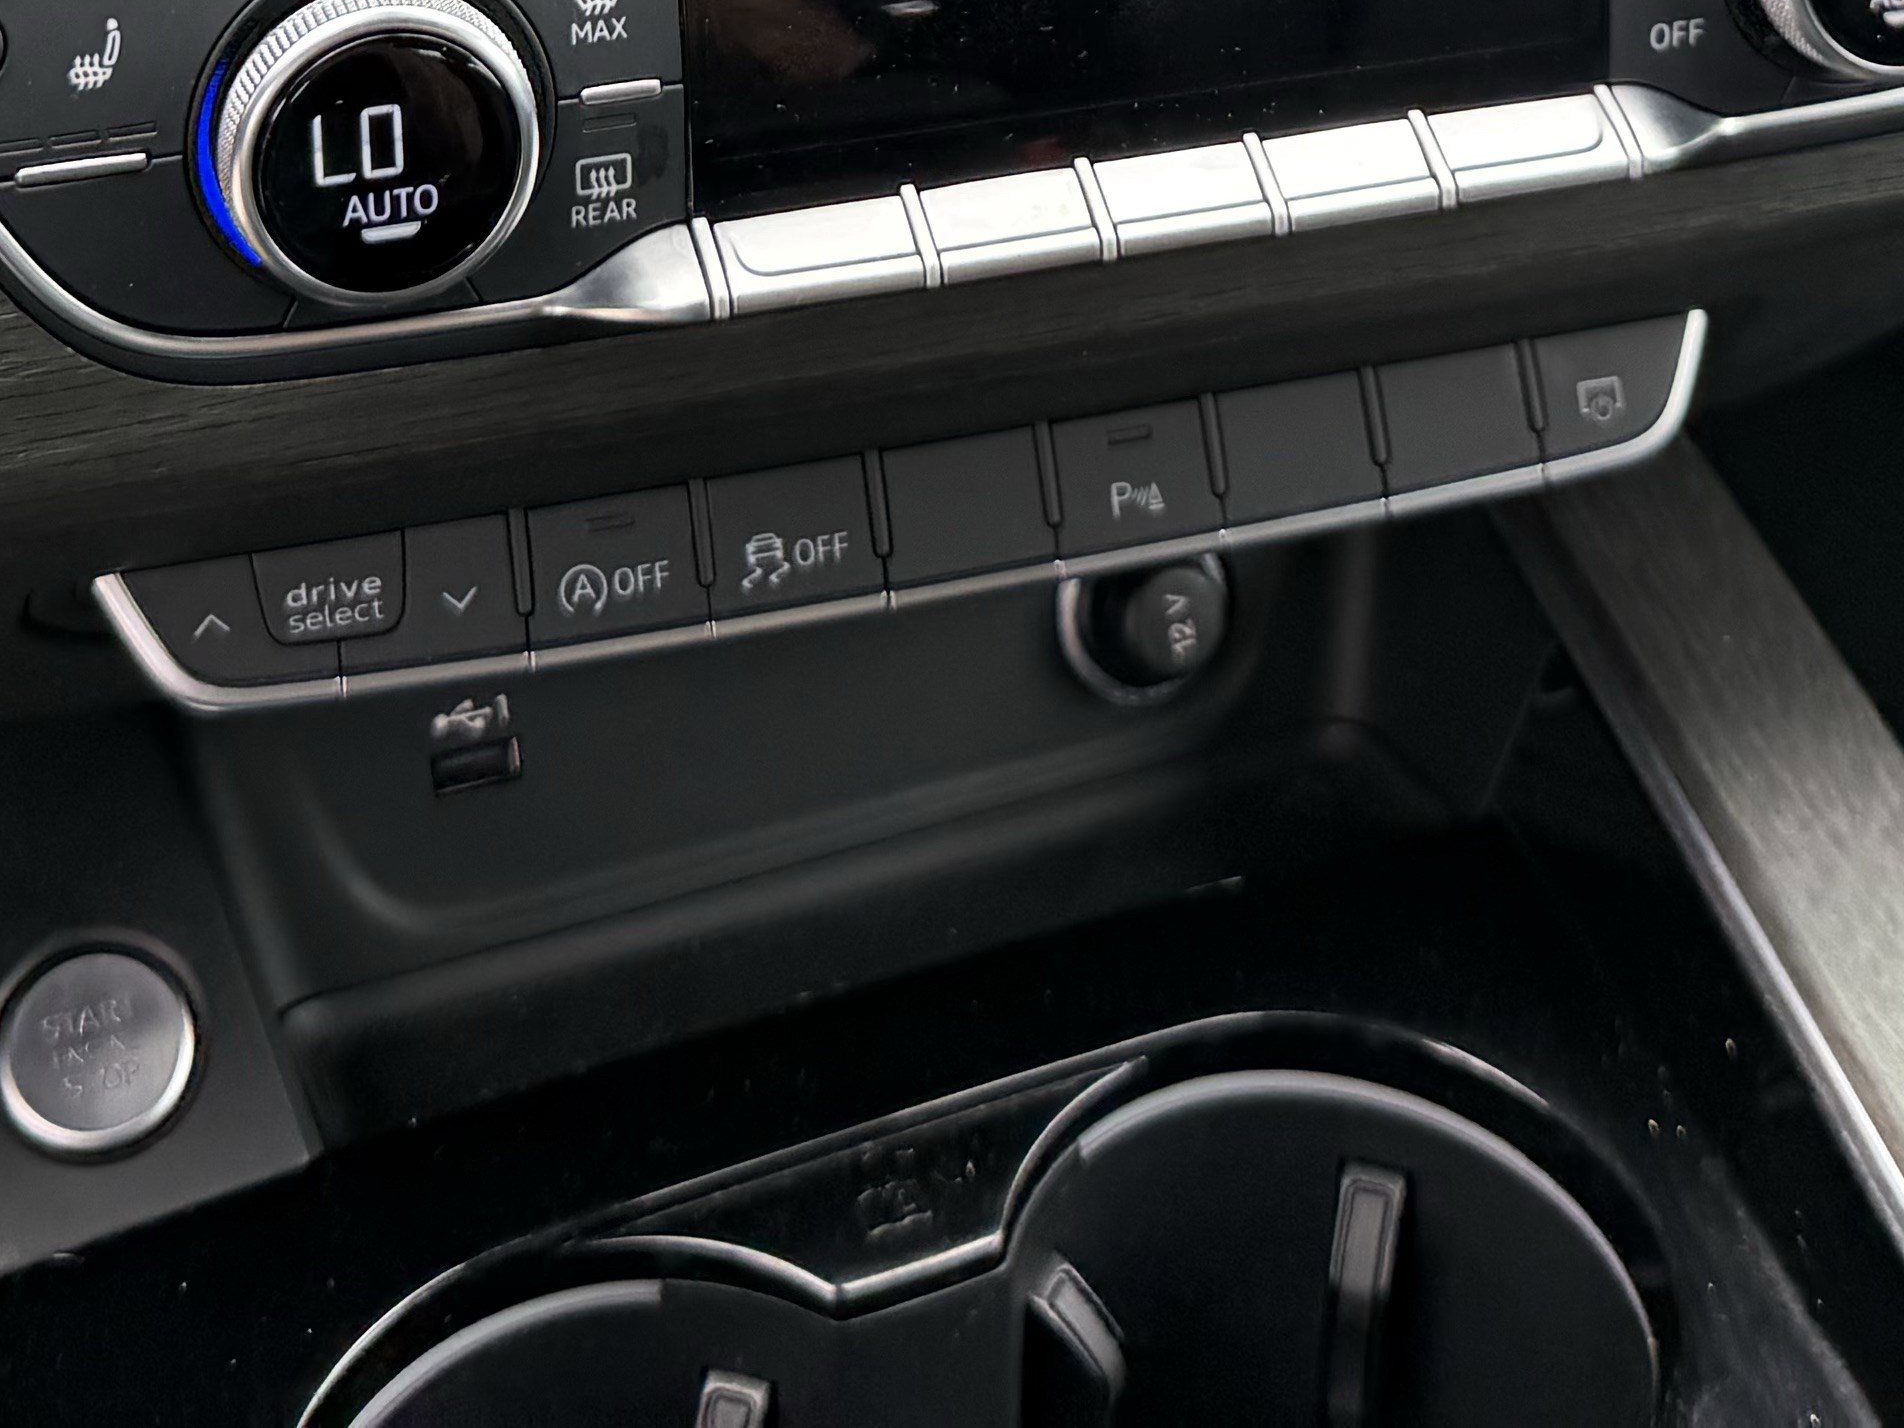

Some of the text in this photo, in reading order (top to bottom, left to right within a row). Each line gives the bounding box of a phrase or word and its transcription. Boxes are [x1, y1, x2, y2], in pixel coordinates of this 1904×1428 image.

[570, 13, 628, 46] MAX
[1649, 17, 1705, 51] OFF
[312, 103, 404, 187] LO
[343, 183, 439, 227] AUTO
[570, 194, 637, 228] REAR
[792, 531, 848, 568] OFF
[286, 574, 383, 609] drive
[612, 558, 671, 597] OFF
[287, 596, 386, 635] select
[62, 1058, 141, 1096] SOP
